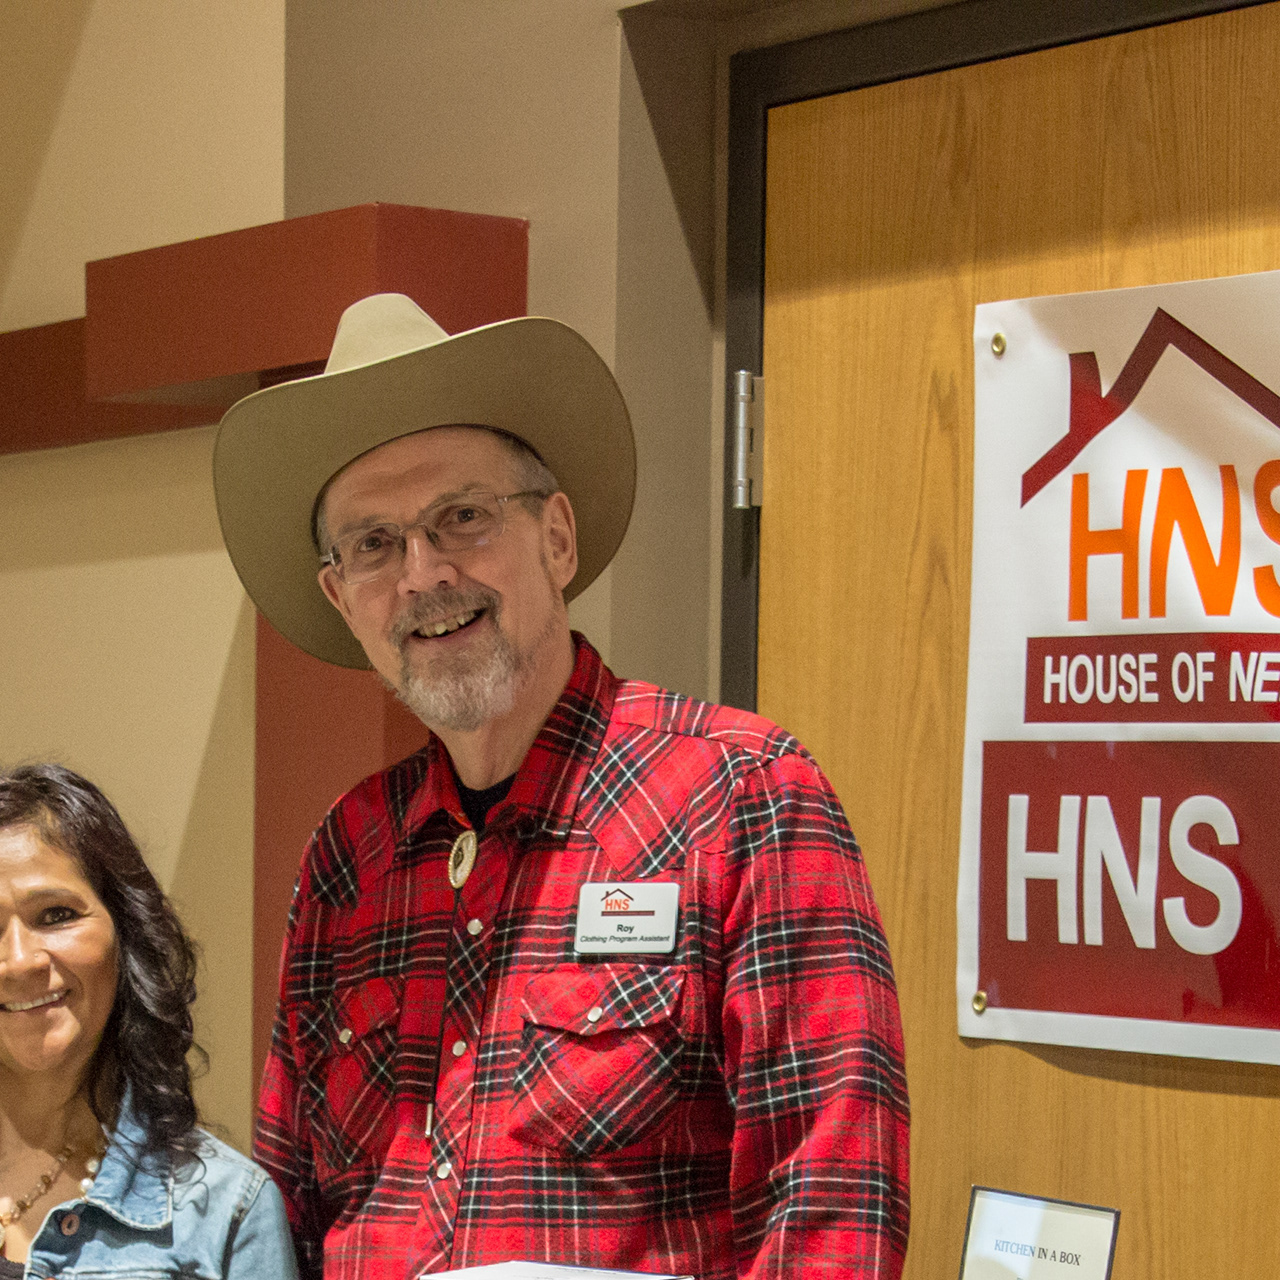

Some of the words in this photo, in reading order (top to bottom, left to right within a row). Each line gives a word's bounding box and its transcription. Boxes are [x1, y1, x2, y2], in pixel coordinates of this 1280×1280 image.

[1044, 654, 1160, 704] HOUSE
[1171, 653, 1216, 704] OF
[1006, 793, 1242, 957] HNS
[605, 899, 630, 911] HNS
[616, 924, 634, 934] Roy
[994, 1239, 1036, 1257] KITCHEN
[1037, 1247, 1048, 1260] IN
[1050, 1250, 1057, 1262] A
[1059, 1251, 1082, 1266] BOX
